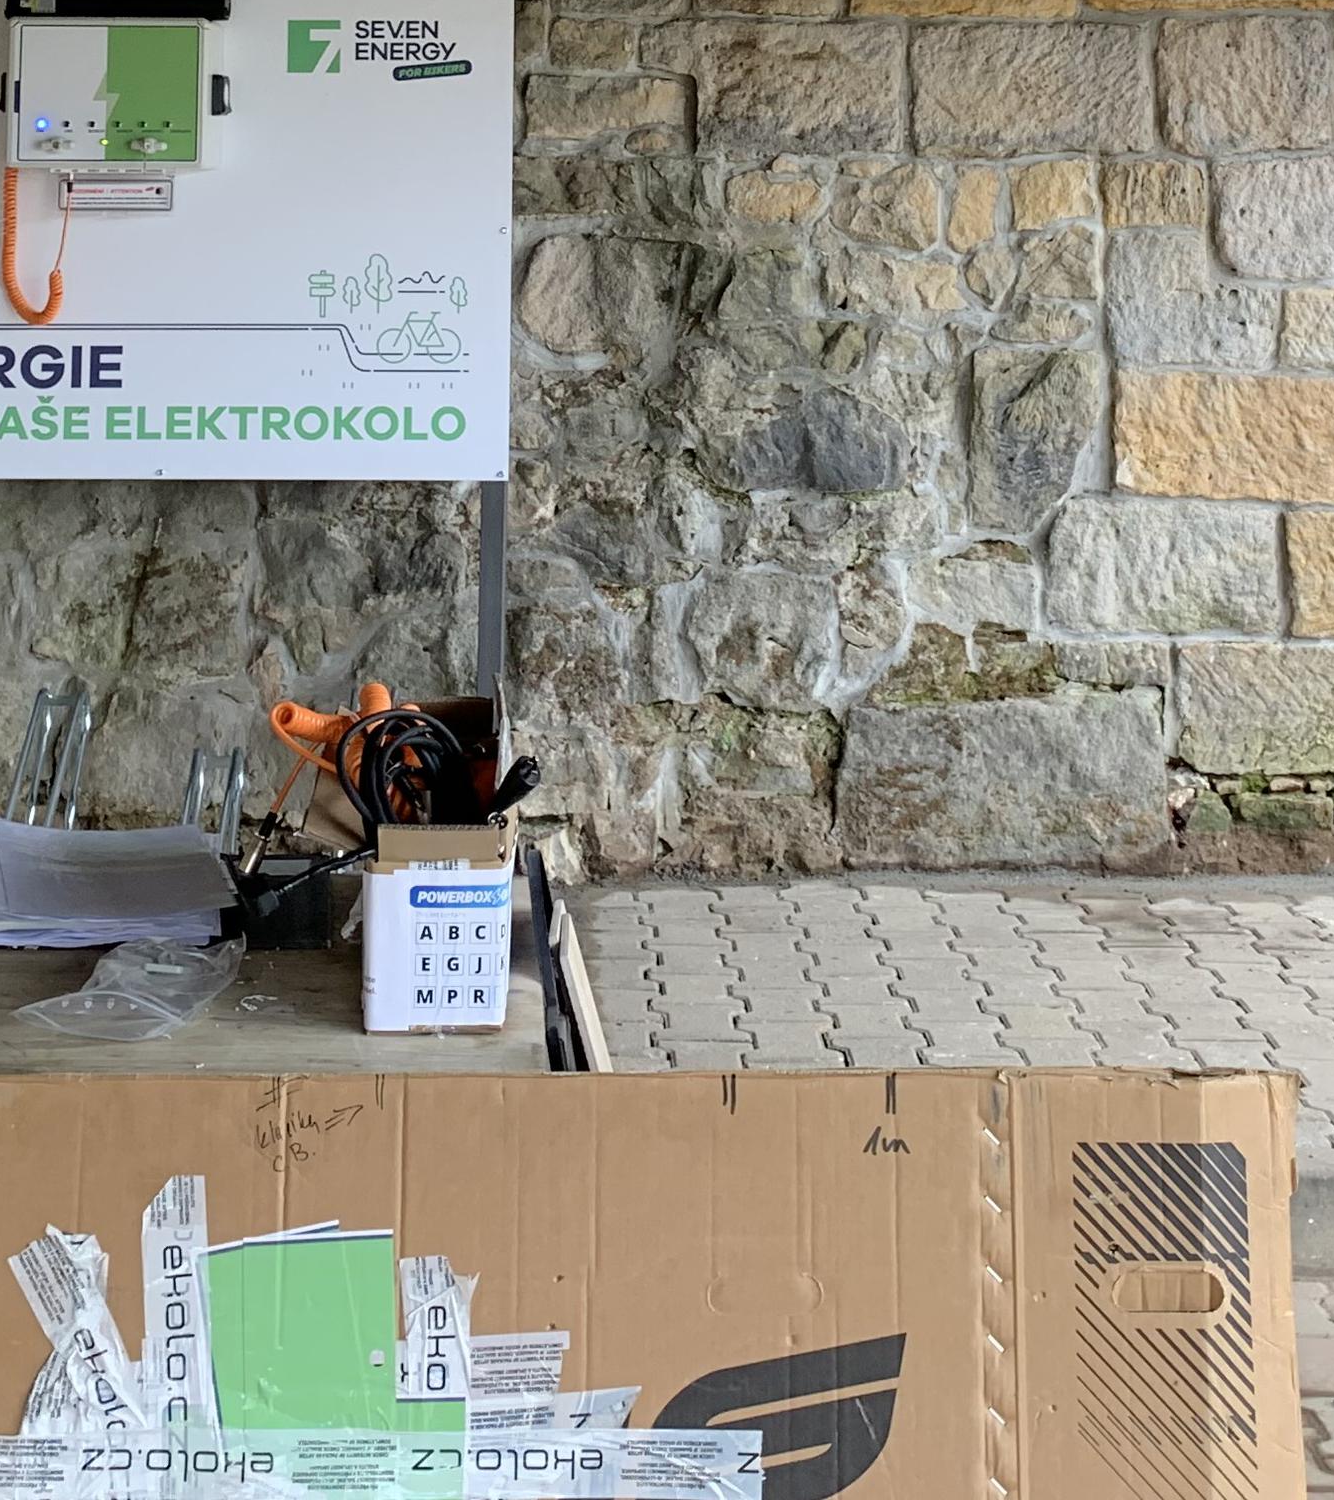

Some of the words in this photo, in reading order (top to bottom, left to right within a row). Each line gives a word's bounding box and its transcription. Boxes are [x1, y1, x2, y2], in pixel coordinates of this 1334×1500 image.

[354, 42, 457, 61] ENERGY
[398, 67, 423, 78] FOR
[106, 406, 466, 441] ELEKTROKOLO
[417, 890, 492, 904] POWERBOX
[419, 925, 434, 940] A
[448, 926, 460, 940] B
[474, 925, 487, 940] C
[421, 957, 431, 971] E
[446, 957, 460, 971] G
[474, 957, 482, 974] J
[416, 989, 434, 1004] M
[447, 989, 458, 1004] P
[473, 989, 485, 1004] R
[425, 1304, 448, 1393] eko
[81, 1448, 276, 1483] ekolo.cz
[411, 1449, 604, 1483] ekolo.cz
